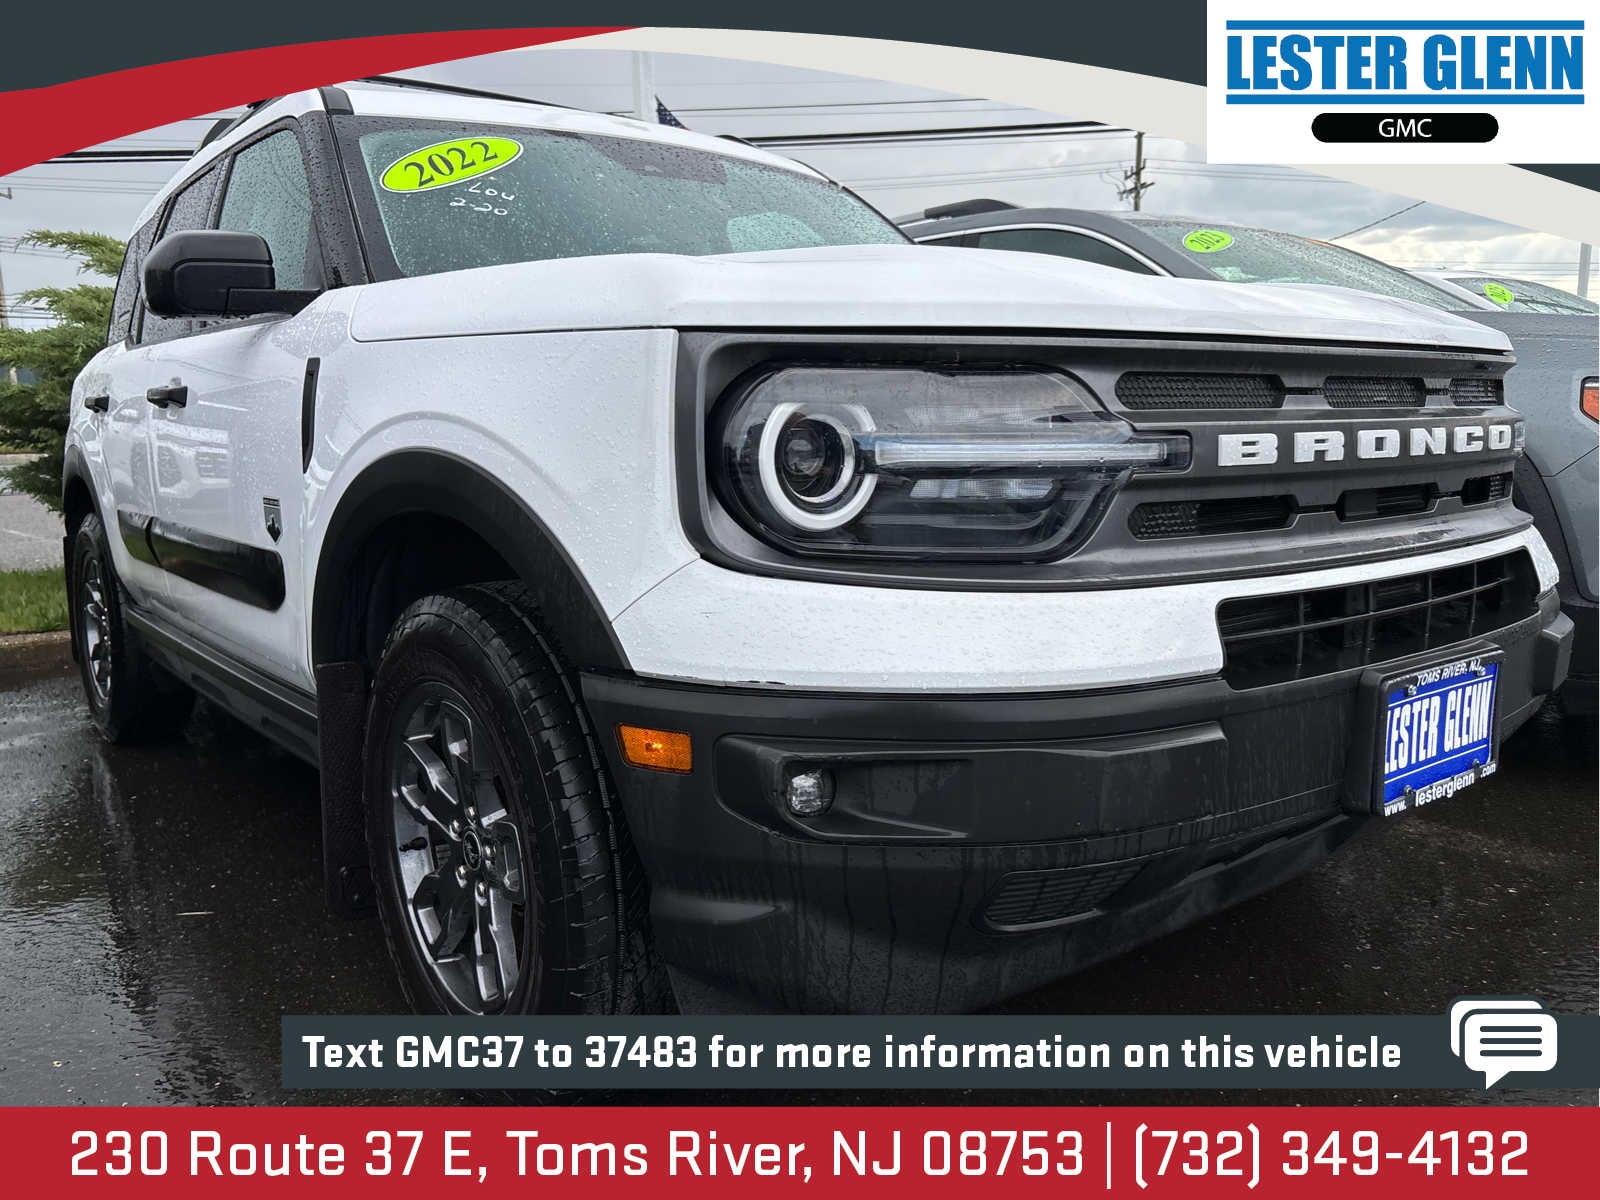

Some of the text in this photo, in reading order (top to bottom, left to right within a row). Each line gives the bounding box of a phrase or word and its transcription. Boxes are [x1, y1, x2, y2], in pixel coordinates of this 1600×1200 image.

[404, 141, 498, 187] 2022
[1218, 424, 1512, 467] BRONCO
[1416, 669, 1441, 688] TOMS
[1384, 680, 1493, 774] LESTER GLENN
[1384, 762, 1497, 817] www. lesterglenn .com
